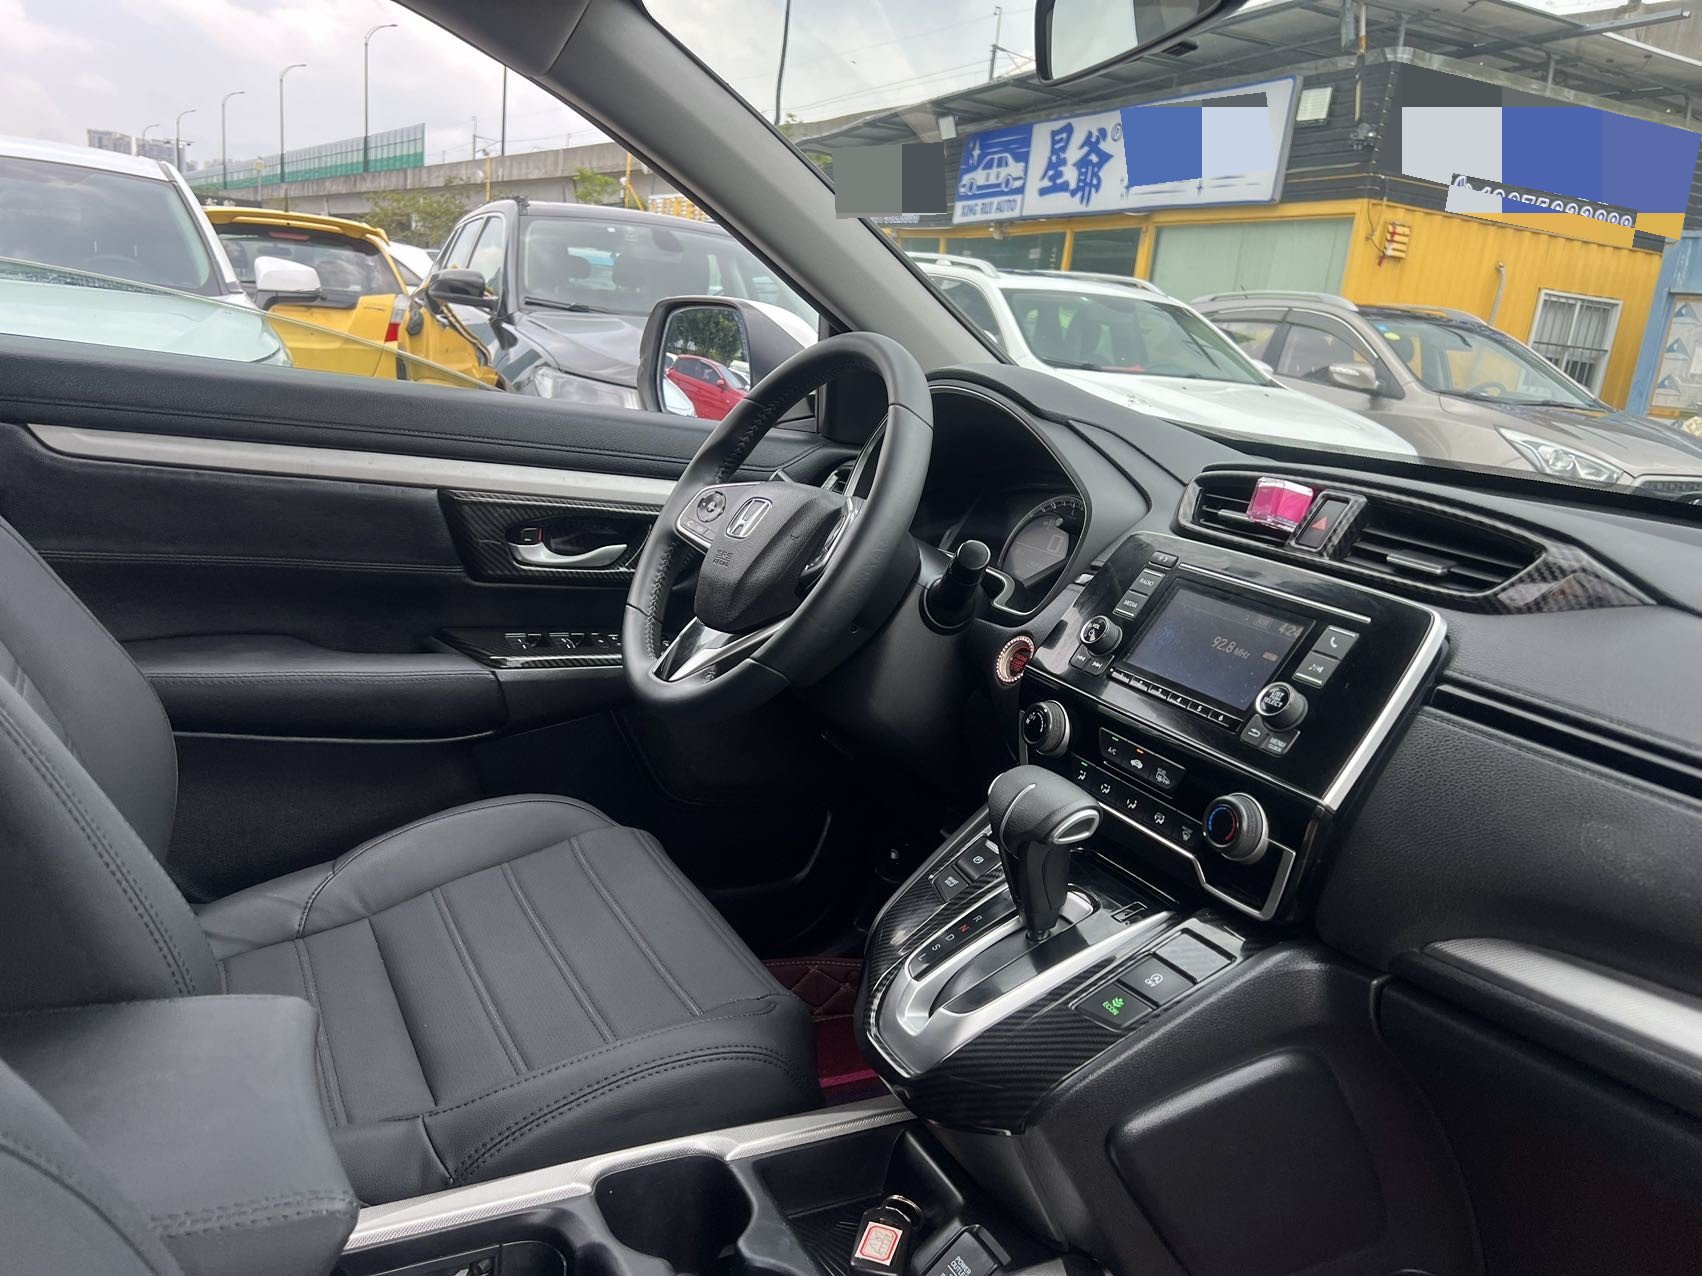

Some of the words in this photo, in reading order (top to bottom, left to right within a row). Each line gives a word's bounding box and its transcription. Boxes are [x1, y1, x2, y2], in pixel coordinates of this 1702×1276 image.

[1211, 635, 1237, 653] 92.8
[945, 933, 955, 941] D
[932, 943, 941, 951] S
[918, 953, 927, 961] L
[954, 1255, 972, 1275] POWER
